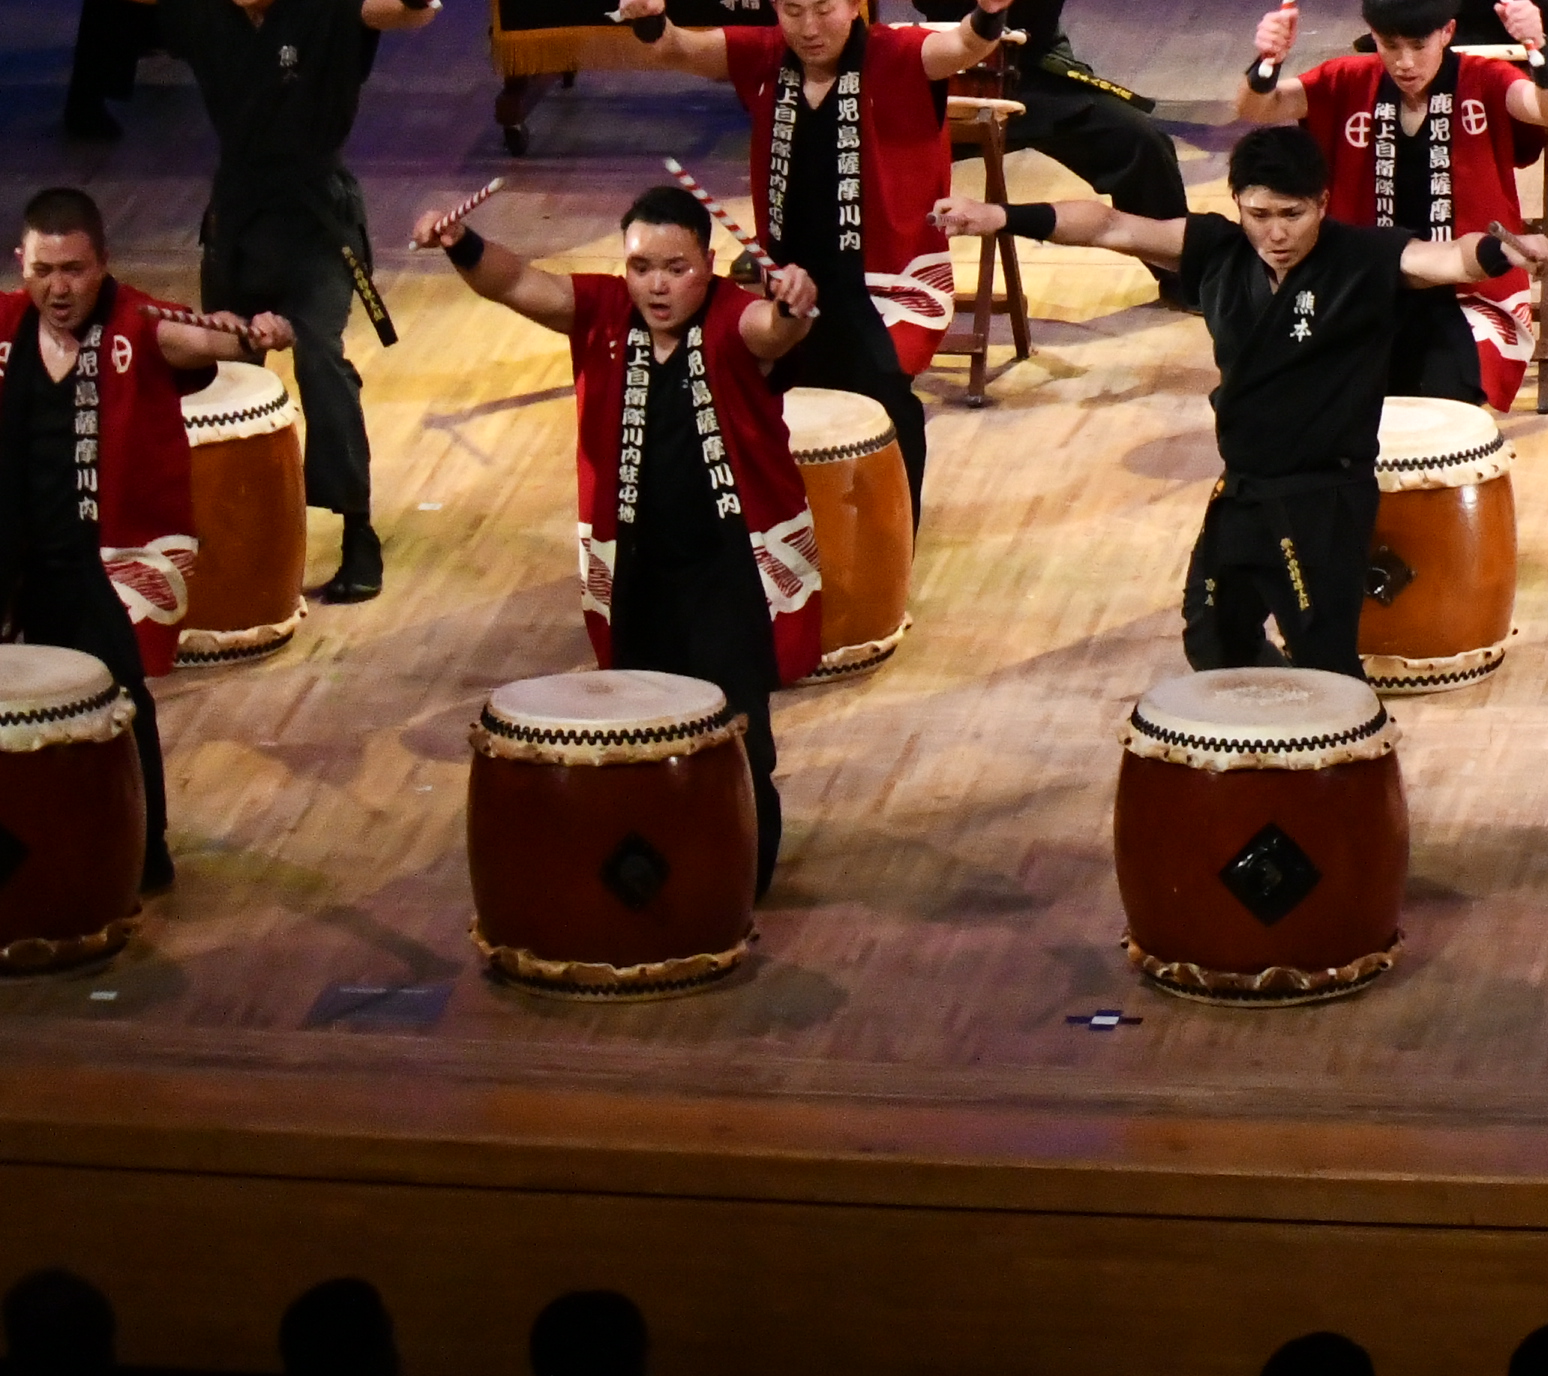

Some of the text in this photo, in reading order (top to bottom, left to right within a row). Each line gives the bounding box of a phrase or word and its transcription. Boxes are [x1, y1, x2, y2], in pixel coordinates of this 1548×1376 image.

[836, 70, 861, 252] 鹿児島薩摩川内
[1289, 290, 1315, 343] 熊本
